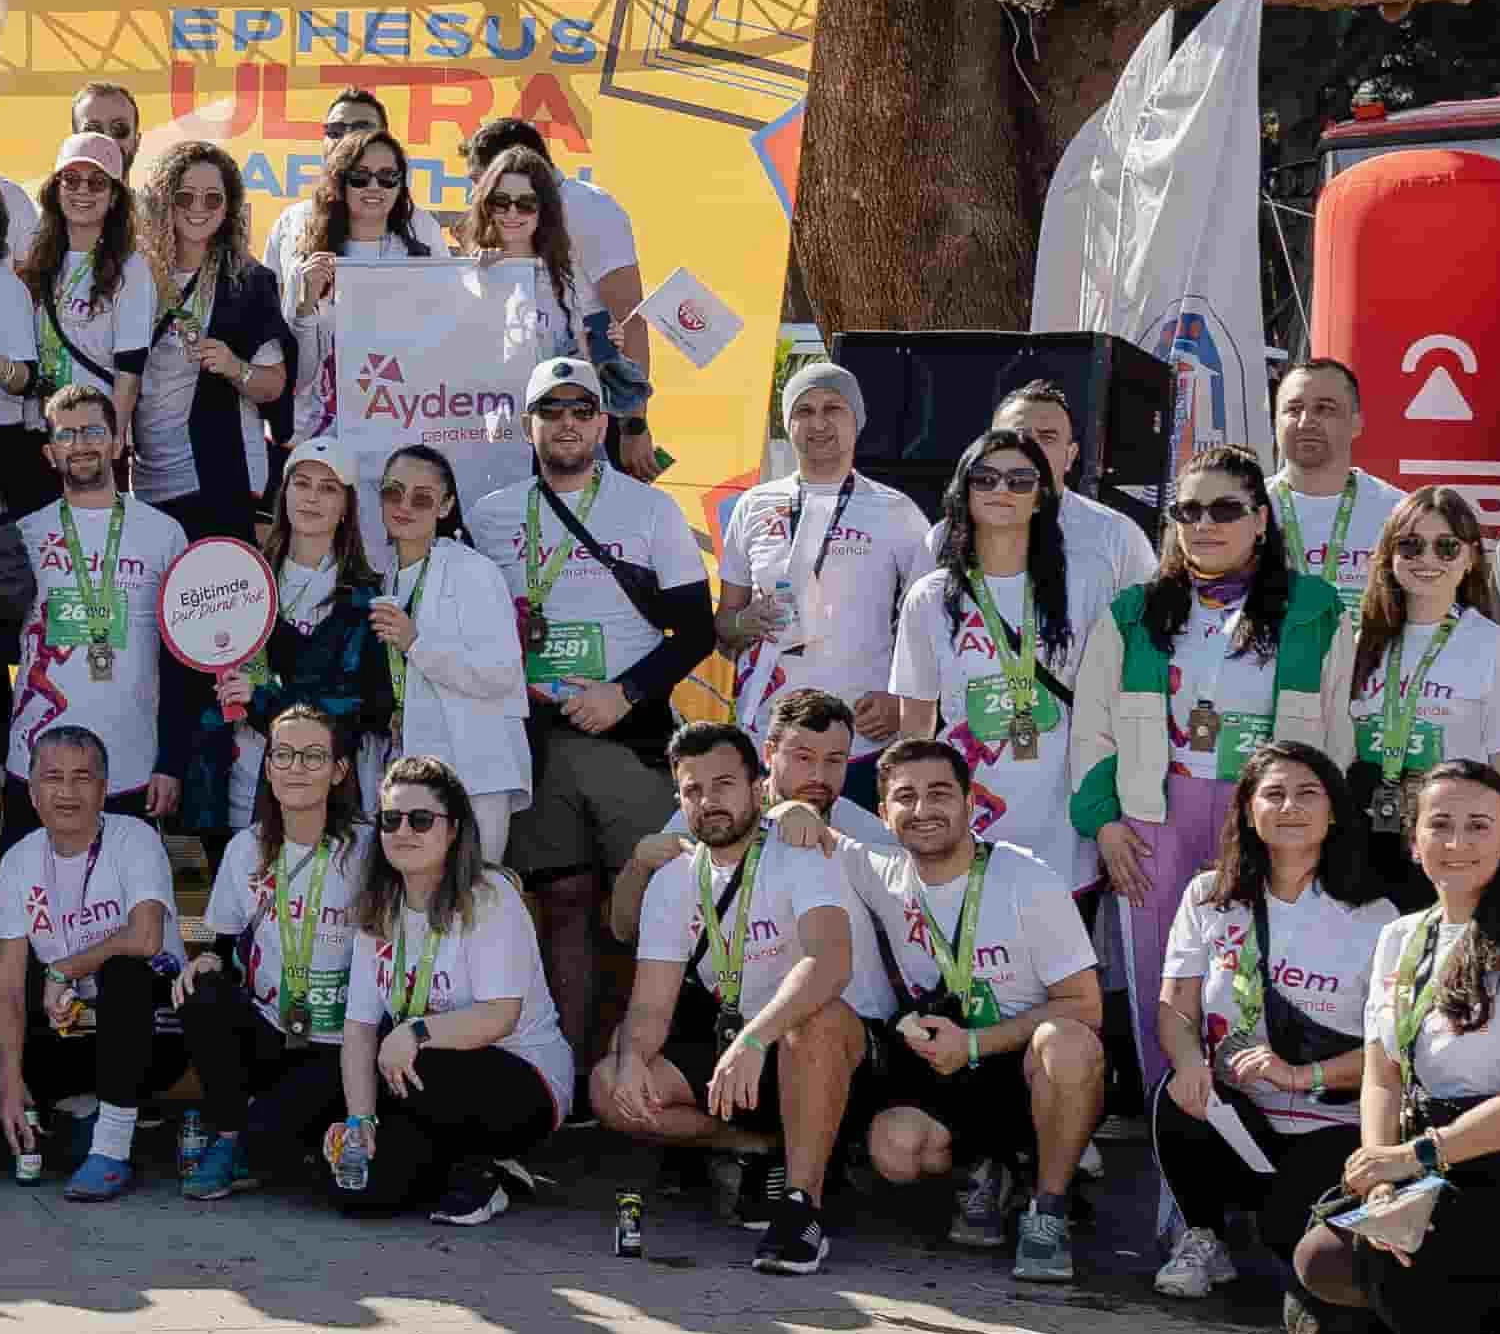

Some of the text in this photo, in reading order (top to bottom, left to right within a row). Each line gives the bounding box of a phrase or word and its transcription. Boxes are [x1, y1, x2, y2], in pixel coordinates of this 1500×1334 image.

[171, 7, 598, 64] EPHESUS
[365, 379, 515, 430] Aydem
[179, 578, 250, 608] Eğitimde
